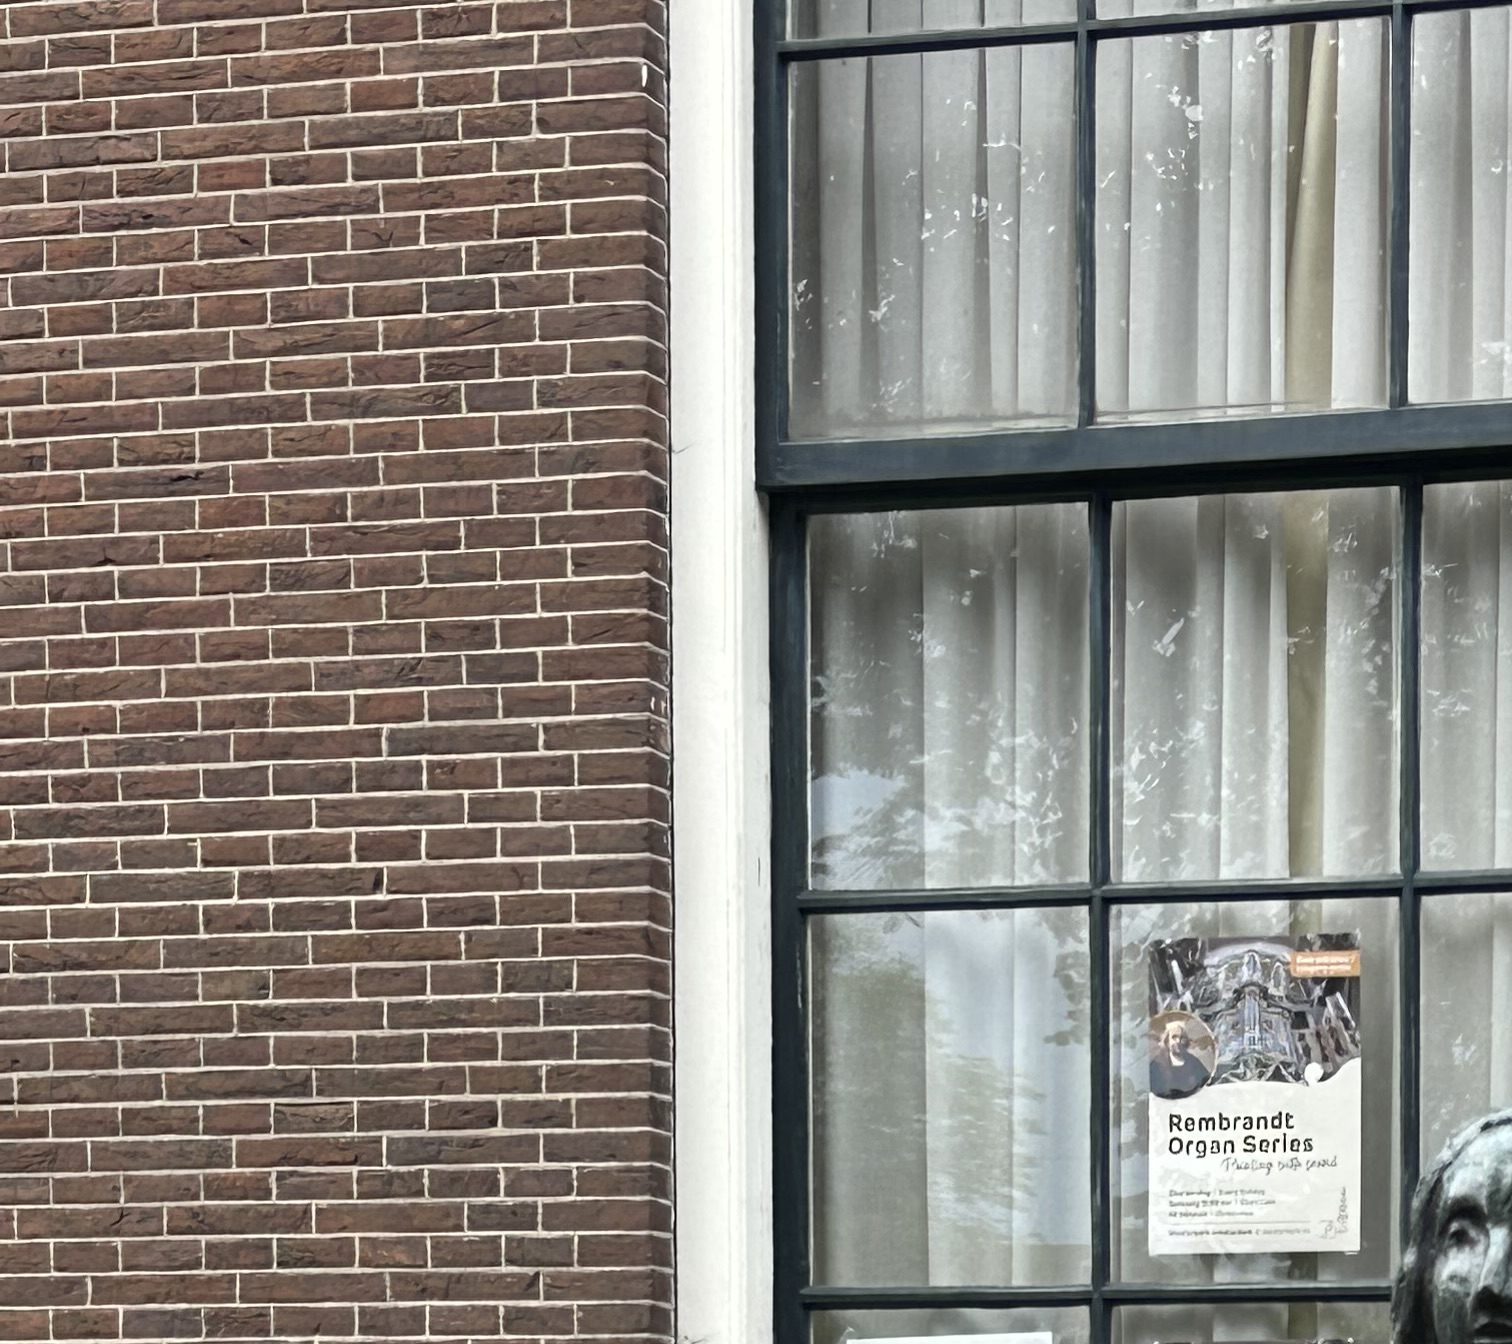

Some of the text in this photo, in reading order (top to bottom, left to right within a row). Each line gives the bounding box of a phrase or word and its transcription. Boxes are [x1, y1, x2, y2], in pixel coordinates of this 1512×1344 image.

[1169, 1111, 1295, 1133] Rembrandt
[1168, 1132, 1314, 1159] Organ Series
